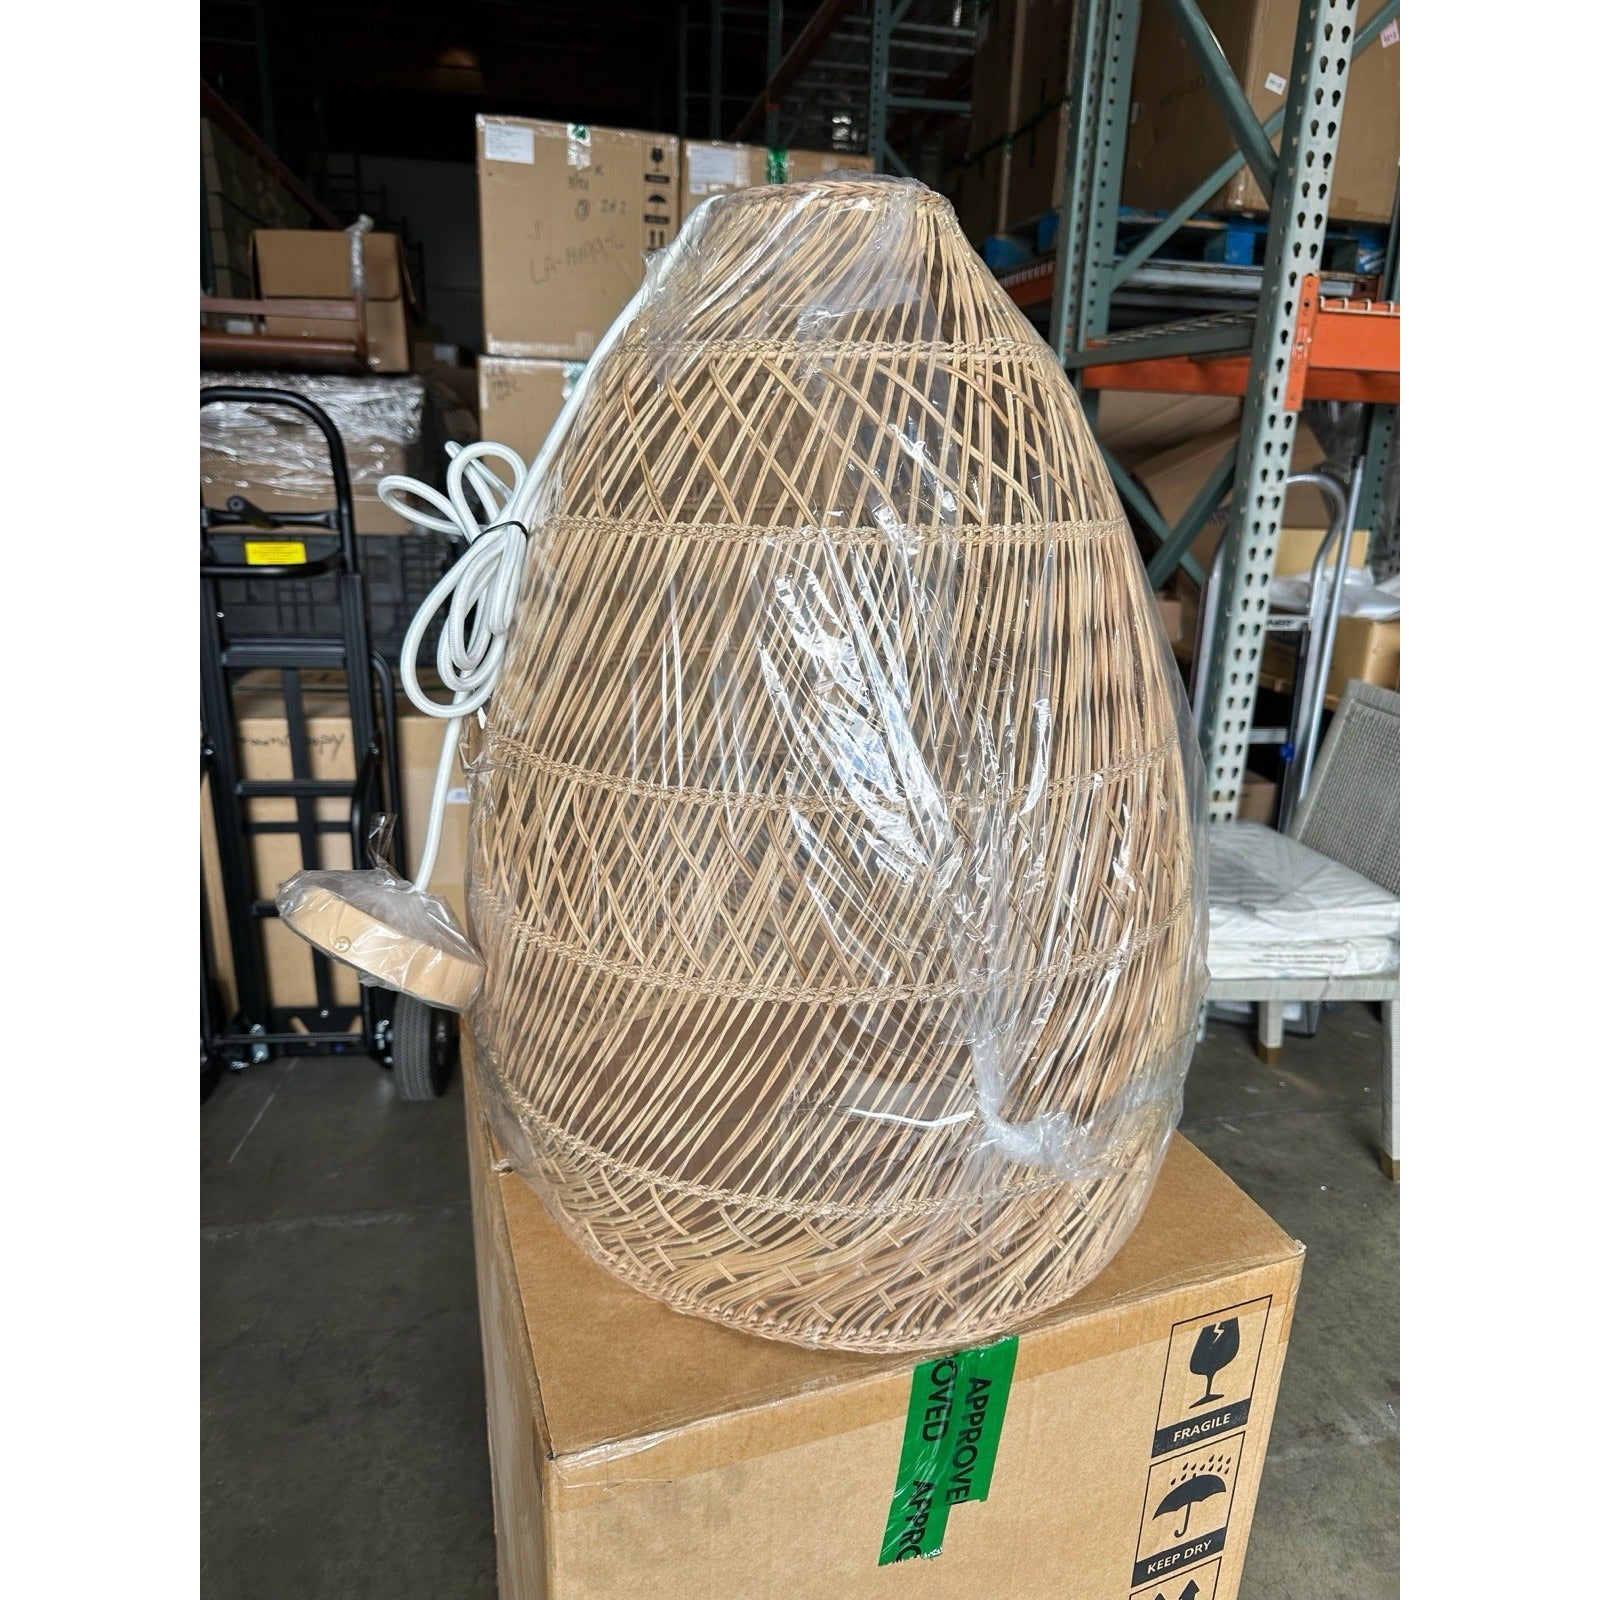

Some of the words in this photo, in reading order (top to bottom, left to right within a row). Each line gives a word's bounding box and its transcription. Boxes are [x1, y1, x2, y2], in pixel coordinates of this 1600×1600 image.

[922, 1354, 959, 1442] OVED
[1173, 1413, 1231, 1442] FRAGILE
[946, 1377, 992, 1505] APPROVE
[1147, 1552, 1180, 1574] KEEP
[1184, 1539, 1212, 1559] DRY
